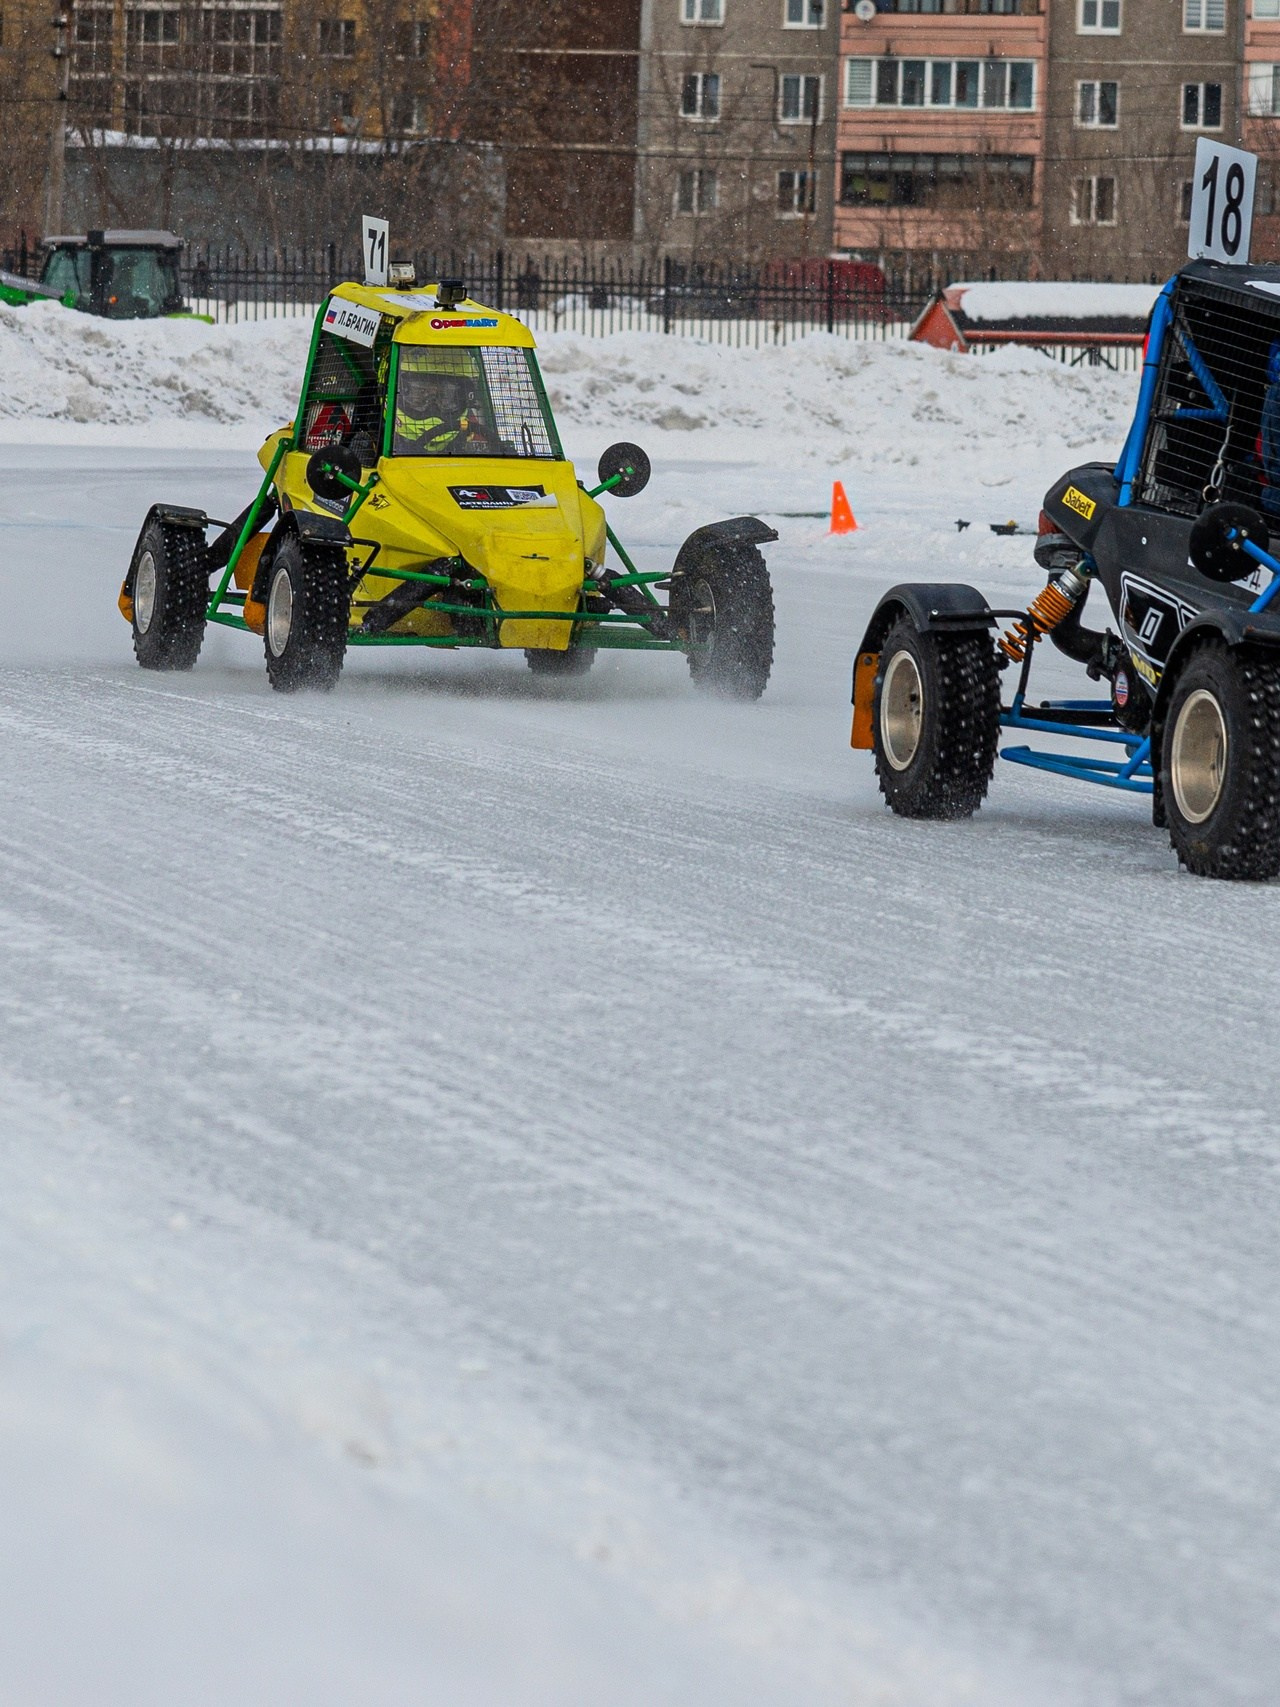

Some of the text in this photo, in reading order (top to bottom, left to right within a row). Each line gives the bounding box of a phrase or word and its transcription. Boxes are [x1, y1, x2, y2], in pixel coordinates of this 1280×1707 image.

[1202, 155, 1245, 257] 18
[368, 228, 386, 273] 71
[338, 310, 377, 337] Л.БРАГИН
[1065, 489, 1092, 517] Sabelt
